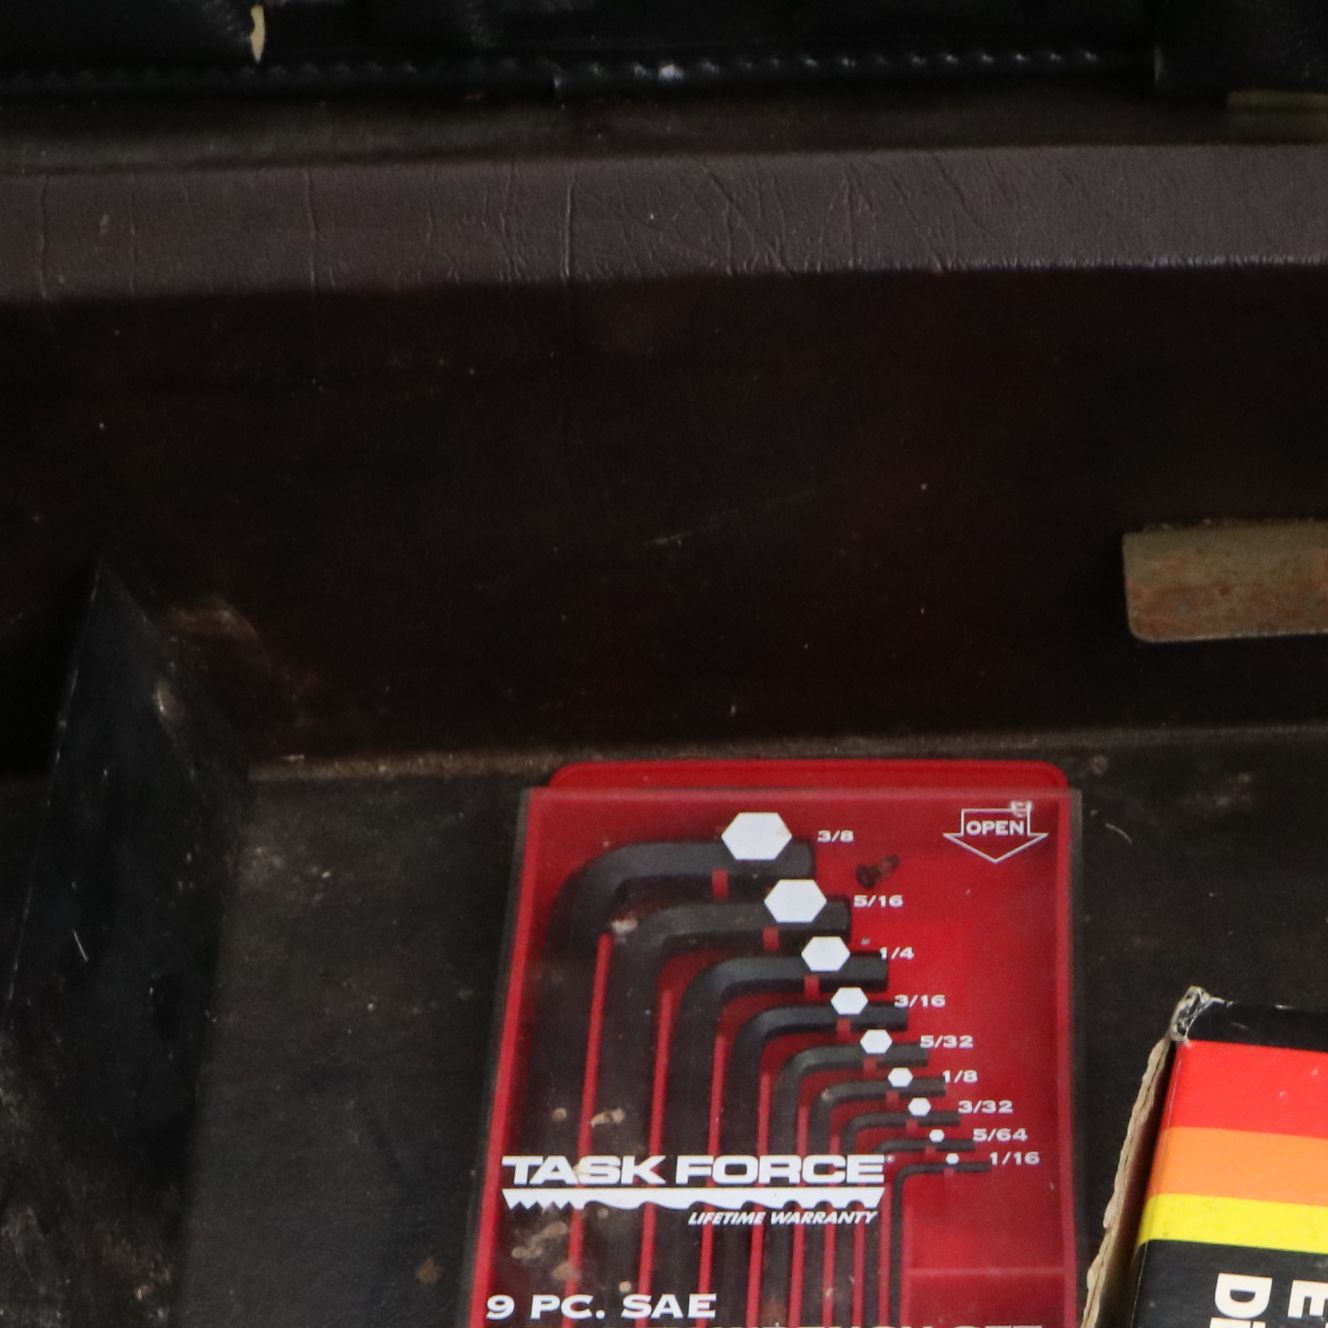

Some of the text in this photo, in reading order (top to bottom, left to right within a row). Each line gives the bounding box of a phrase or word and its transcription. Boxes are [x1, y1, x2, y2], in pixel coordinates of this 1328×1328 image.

[965, 819, 1025, 836] OPEN
[817, 830, 854, 842] 3/8
[853, 895, 904, 908] 5/16
[879, 946, 915, 960] 1/4
[894, 994, 946, 1008] 3/16
[920, 1035, 974, 1049] 5/32
[942, 1070, 978, 1083] 1/8
[958, 1101, 1013, 1114] 3/32
[972, 1128, 1028, 1142] 5/64
[989, 1152, 1040, 1165] 1/16
[502, 1155, 667, 1185] TASK
[688, 1210, 878, 1226] LIFETIME WARRANTY
[486, 1293, 717, 1320] 9 PC. SAE
